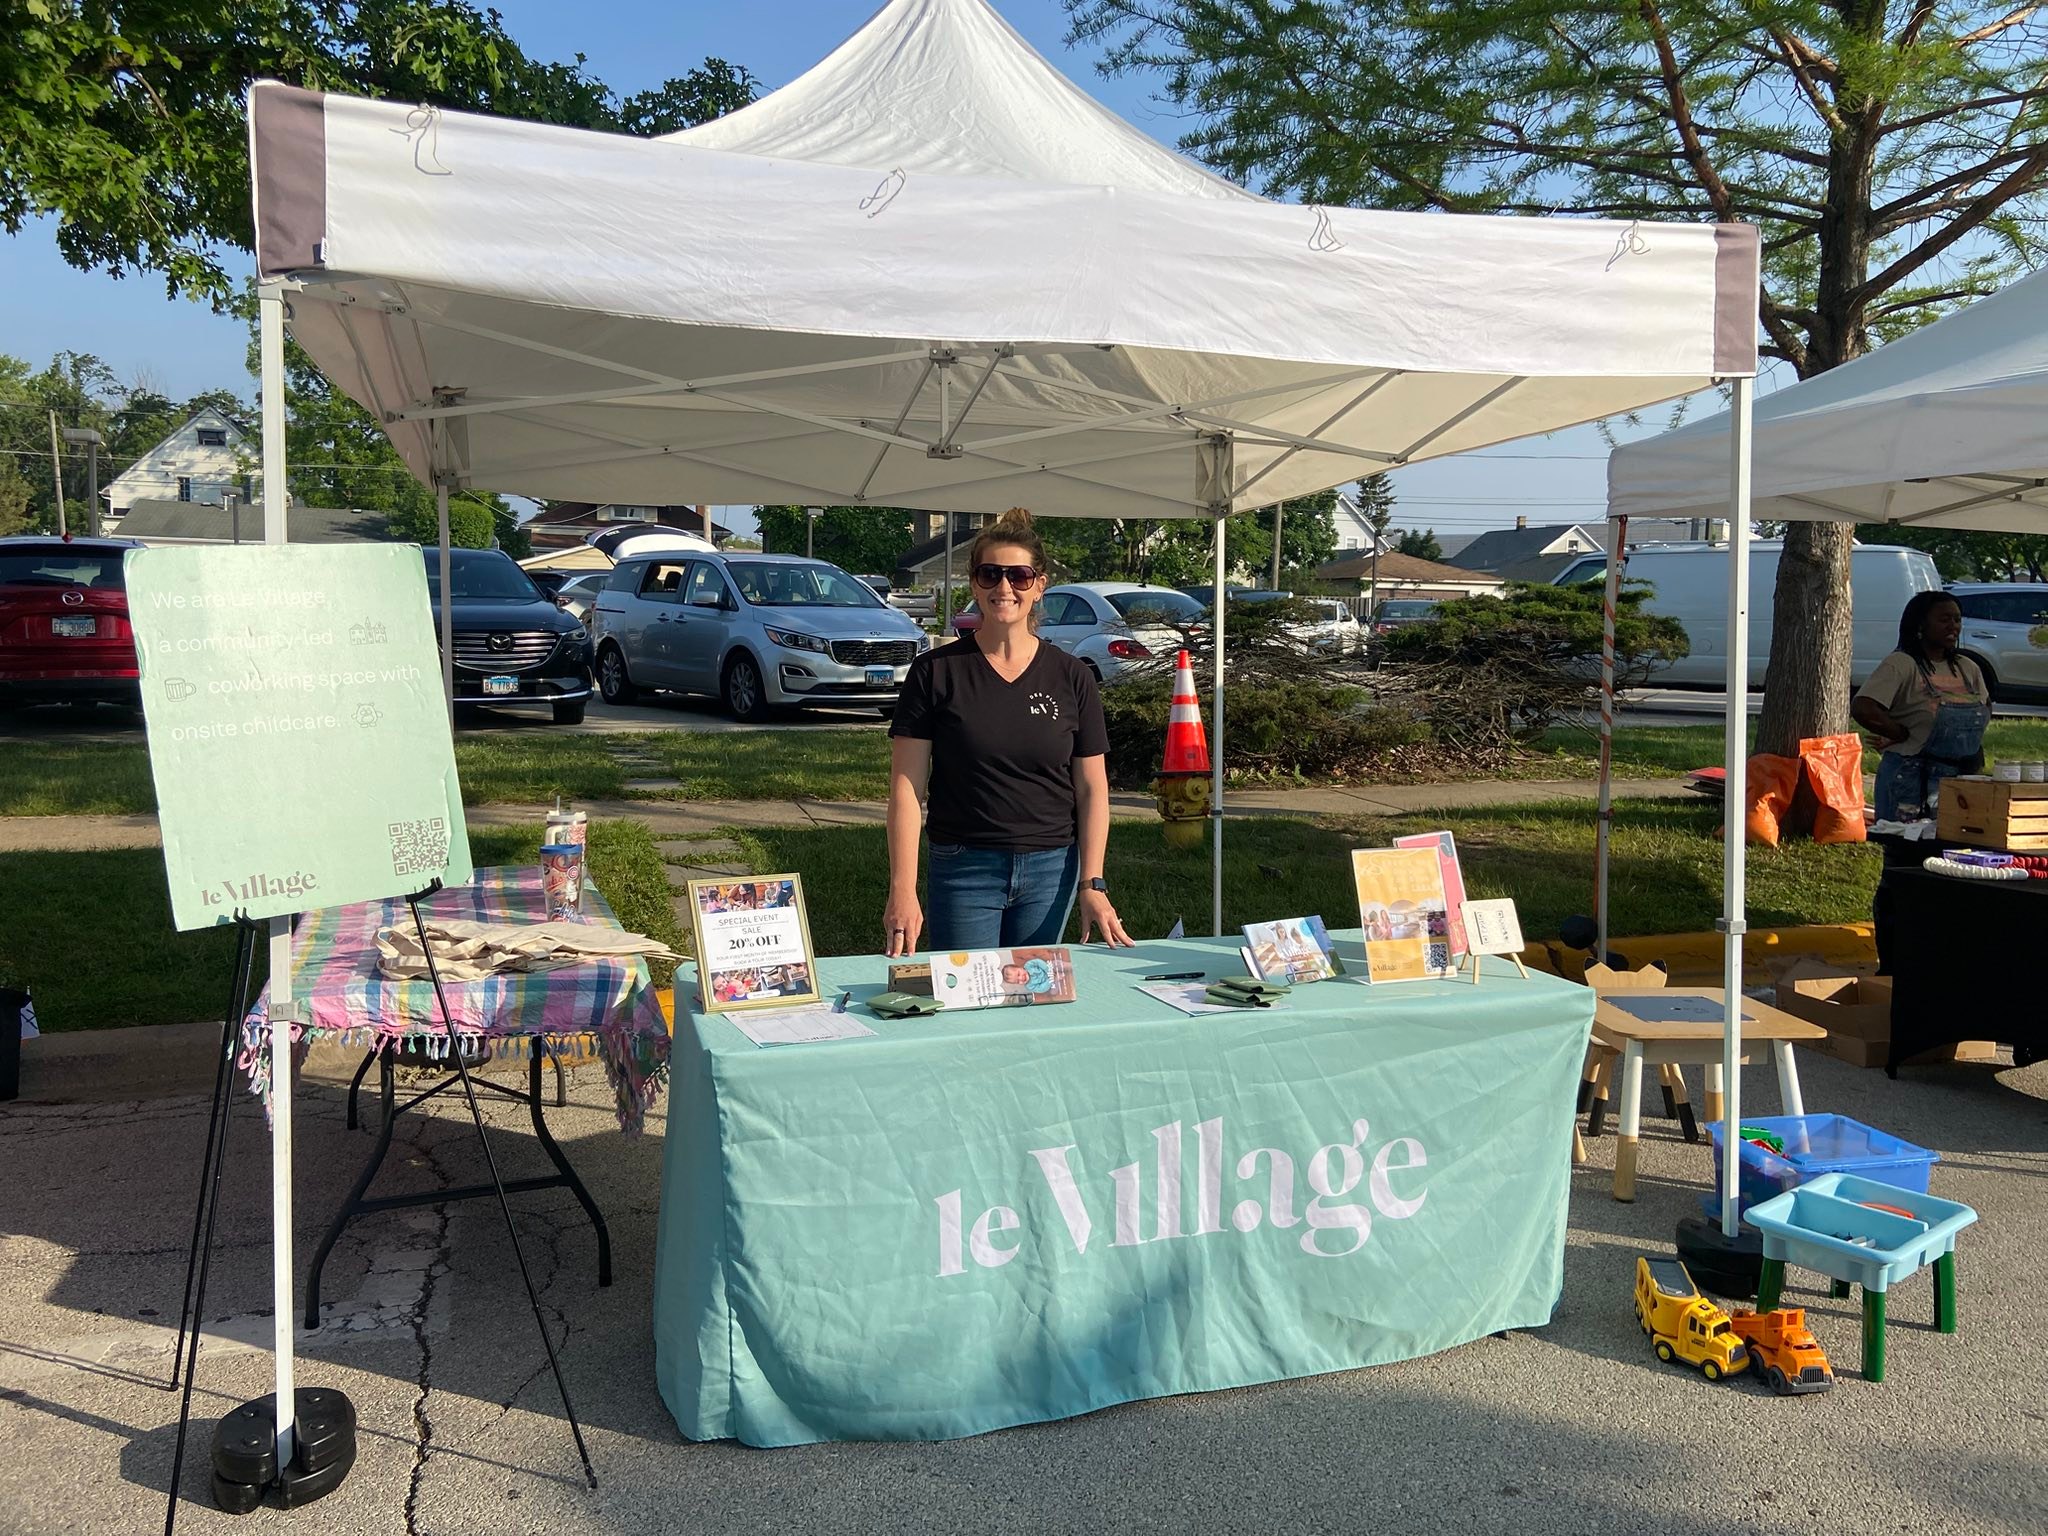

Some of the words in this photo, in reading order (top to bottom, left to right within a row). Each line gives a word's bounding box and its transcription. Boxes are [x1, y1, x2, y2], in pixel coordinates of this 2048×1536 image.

[150, 591, 187, 609] We
[191, 593, 225, 608] are
[159, 639, 172, 653] a
[178, 629, 333, 652] community-led
[208, 671, 316, 694] coworking
[318, 670, 377, 690] space
[379, 664, 421, 682] with
[171, 719, 238, 742] onsite
[242, 713, 342, 736] childcare.
[718, 917, 752, 927] SPECIAL
[753, 913, 779, 923] EVENT
[742, 926, 762, 935] SALE
[728, 937, 755, 950] 20%
[756, 934, 782, 947] OFF
